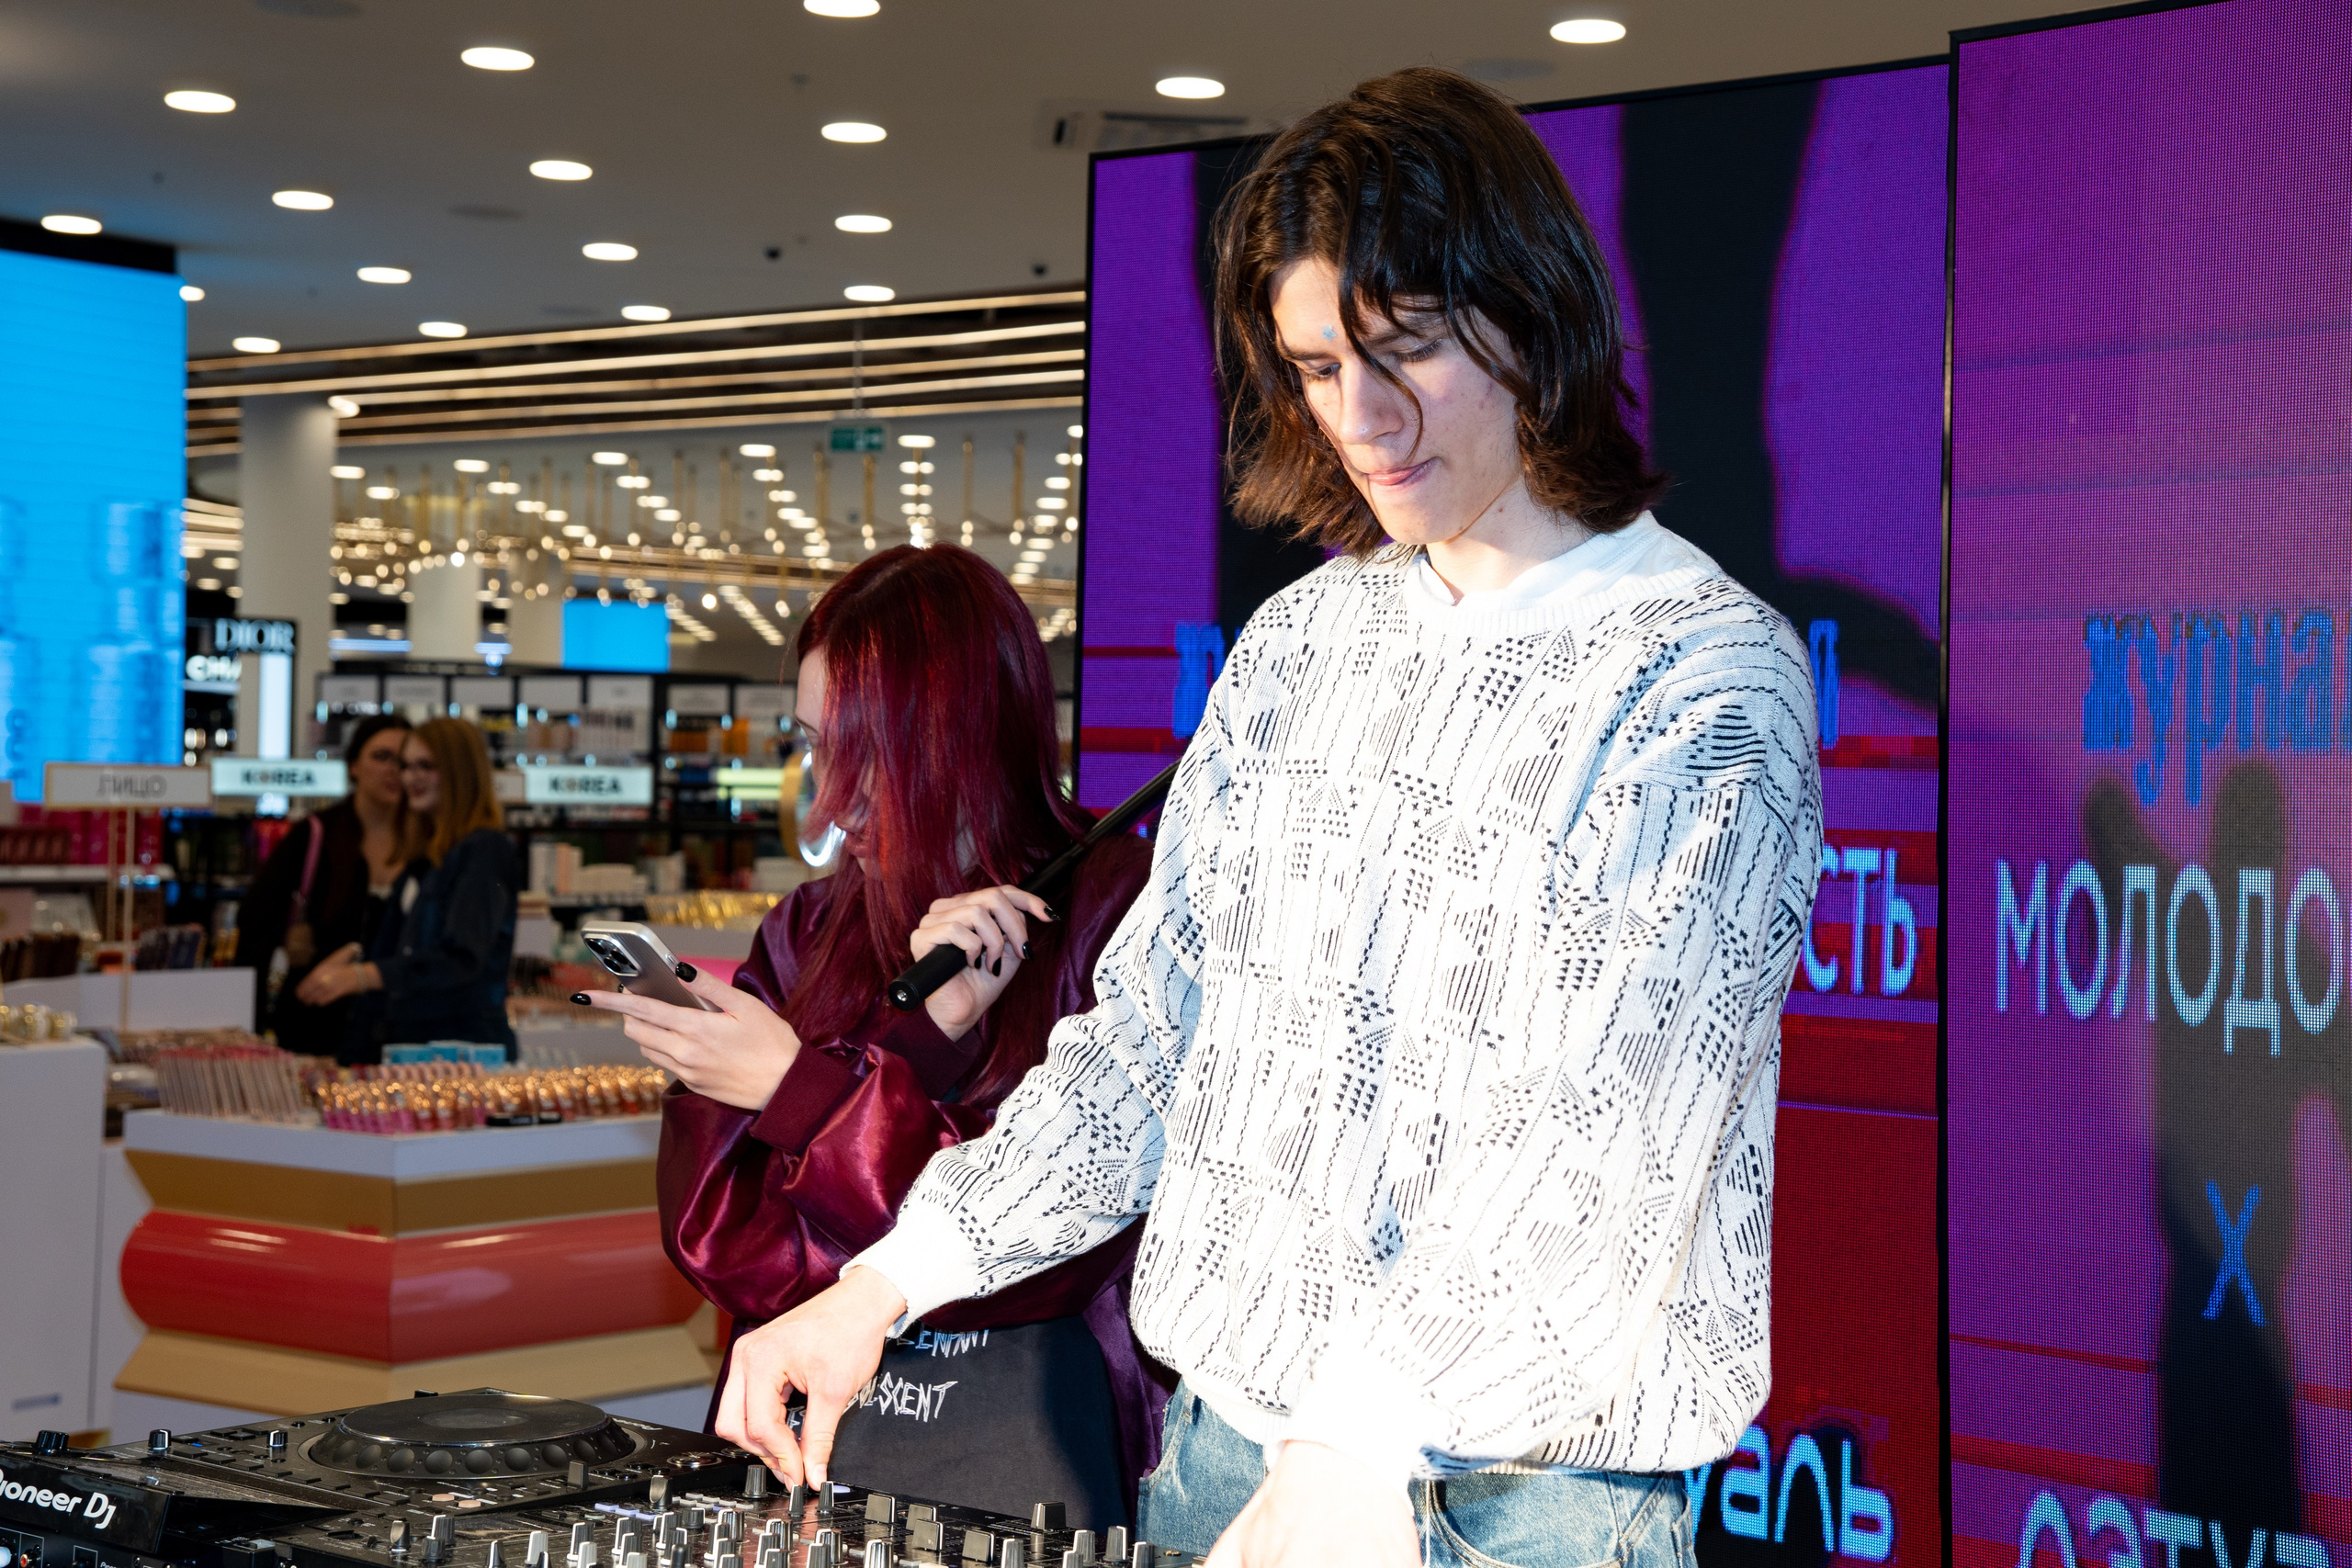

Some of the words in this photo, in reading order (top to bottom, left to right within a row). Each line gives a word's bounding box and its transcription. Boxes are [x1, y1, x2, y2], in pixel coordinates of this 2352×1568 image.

[215, 617, 295, 655] DIOR
[2082, 607, 2352, 808] журна
[241, 767, 316, 784] KOREA
[548, 775, 622, 795] KOREA
[1996, 858, 2344, 1057] МОЛОДО
